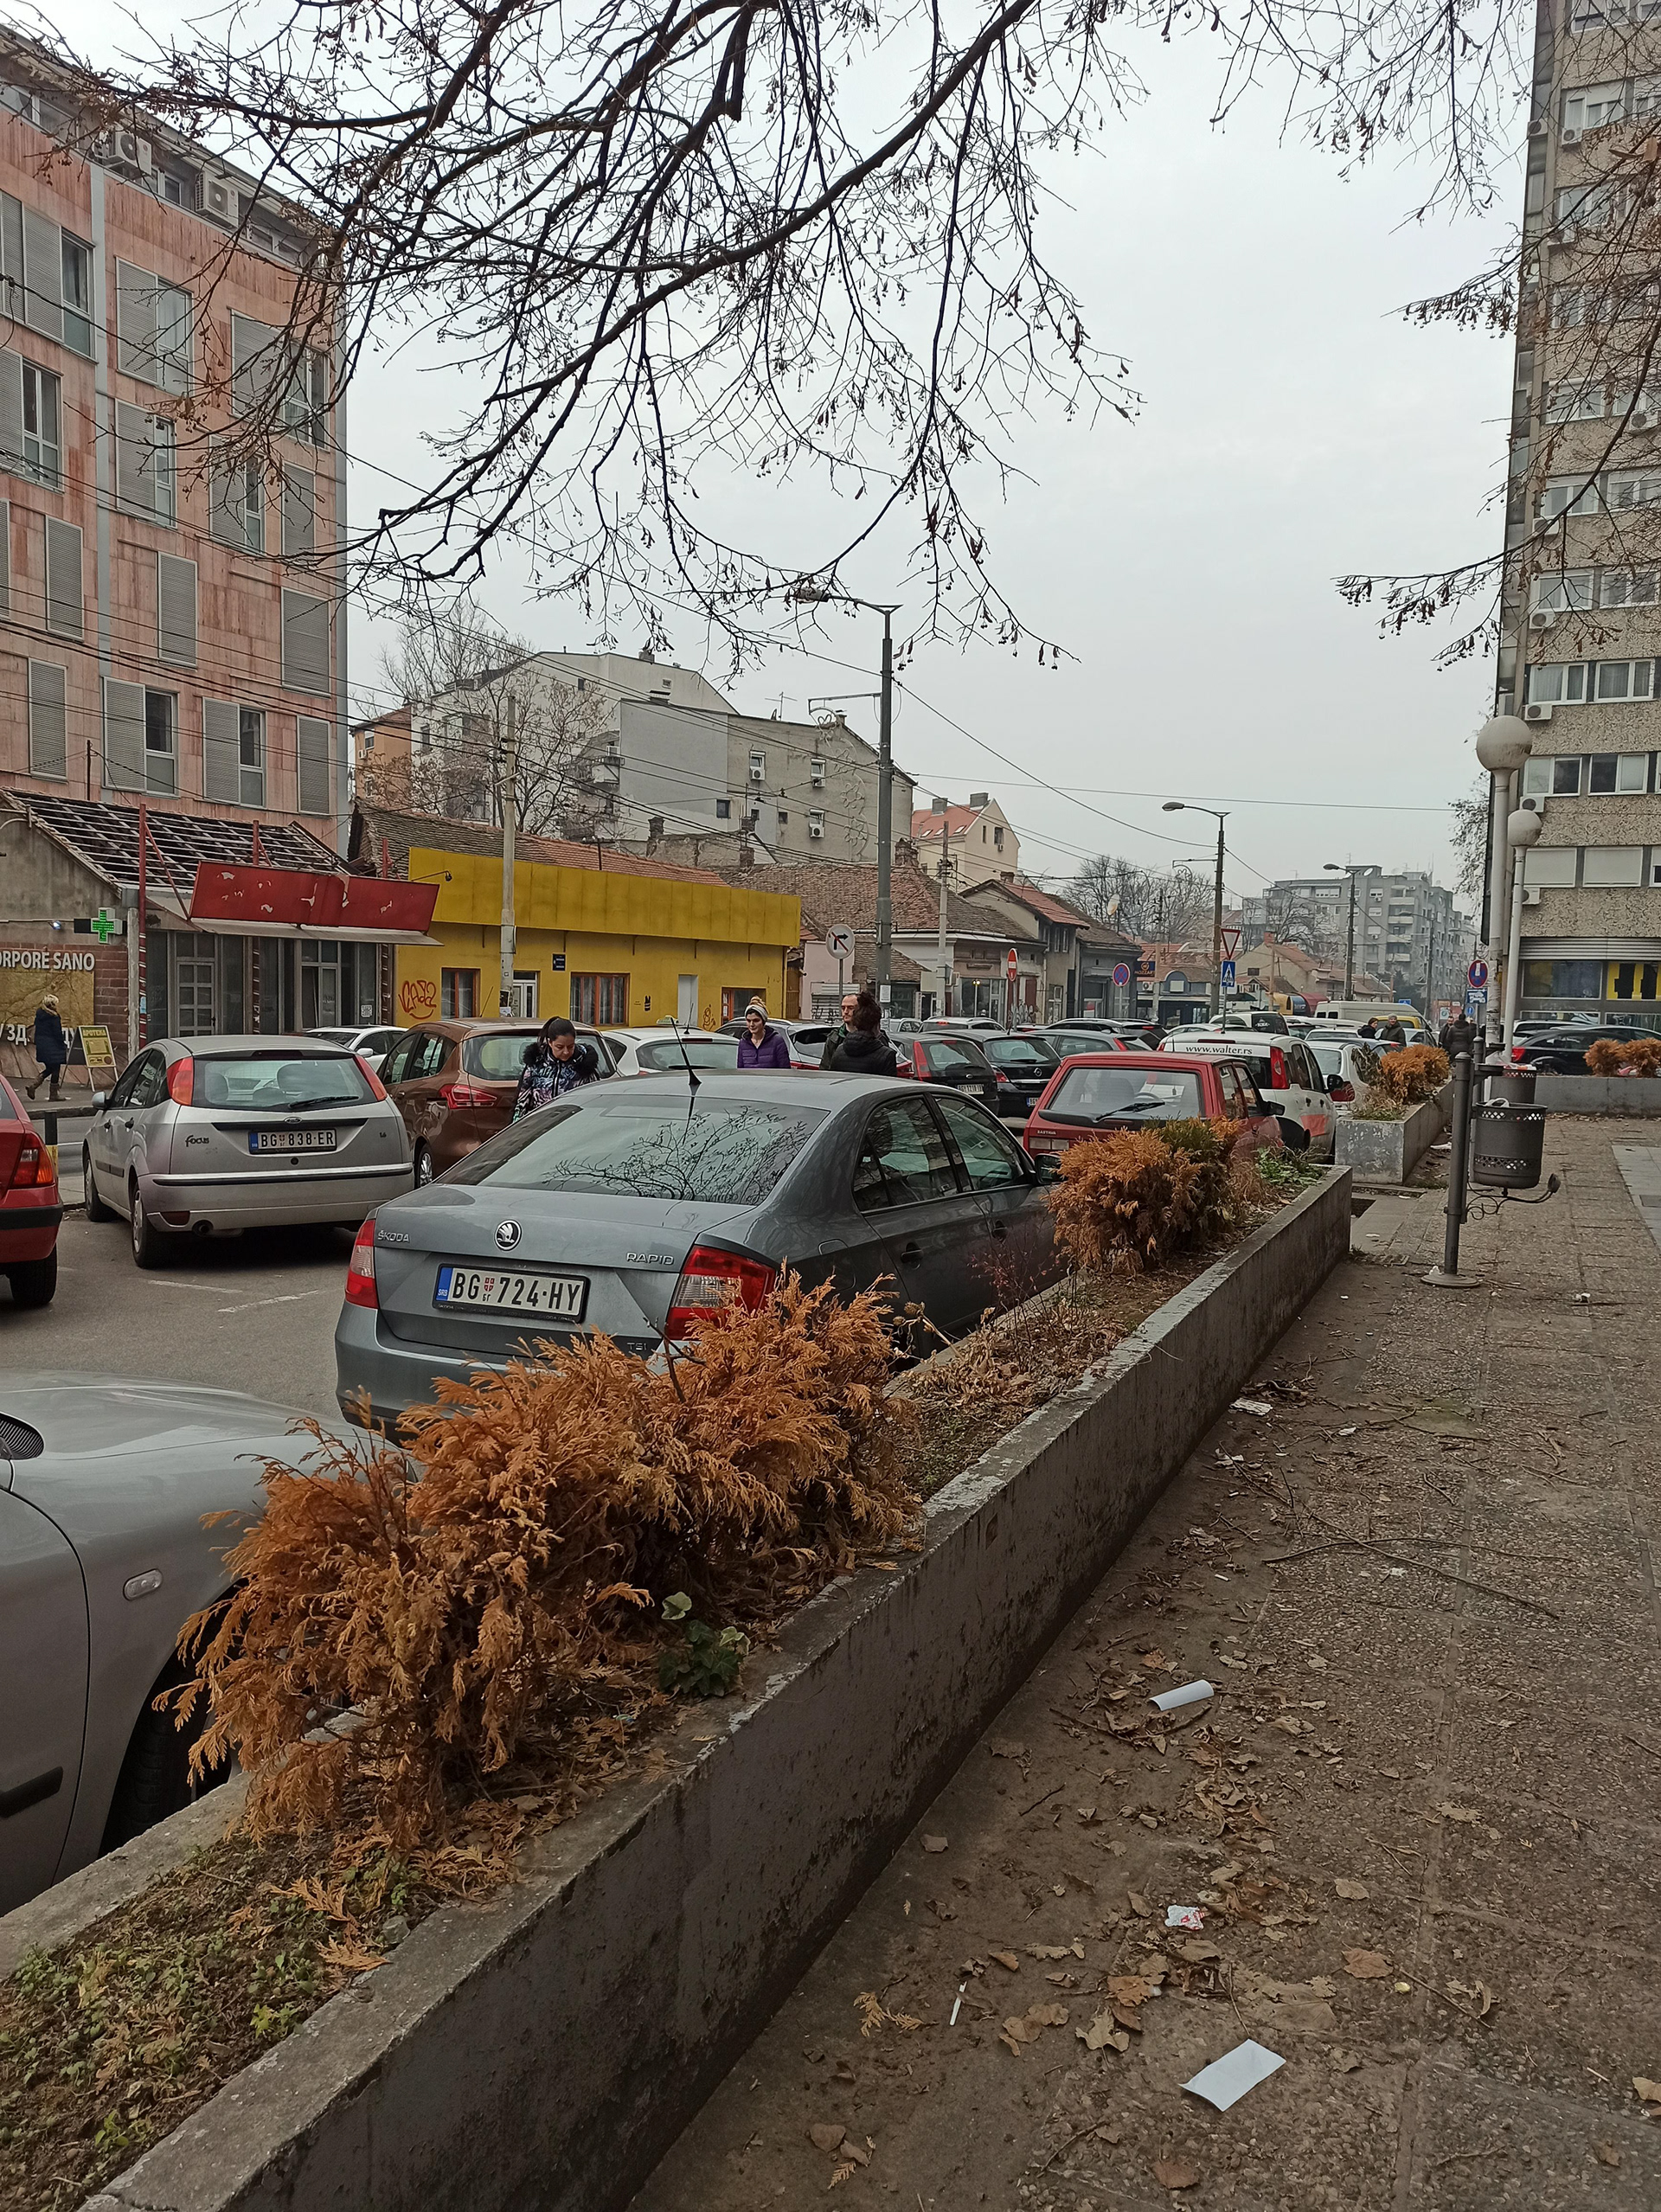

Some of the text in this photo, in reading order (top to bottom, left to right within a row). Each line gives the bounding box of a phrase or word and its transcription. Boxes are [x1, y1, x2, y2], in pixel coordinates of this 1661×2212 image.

[0, 951, 95, 971] RPORE SANO
[1186, 1045, 1253, 1055] www.walter.rs
[260, 1134, 278, 1147] BG
[626, 1252, 675, 1266] RAPID
[437, 1288, 448, 1297] SRB
[452, 1273, 481, 1300] BG
[626, 1342, 647, 1350] TSI
